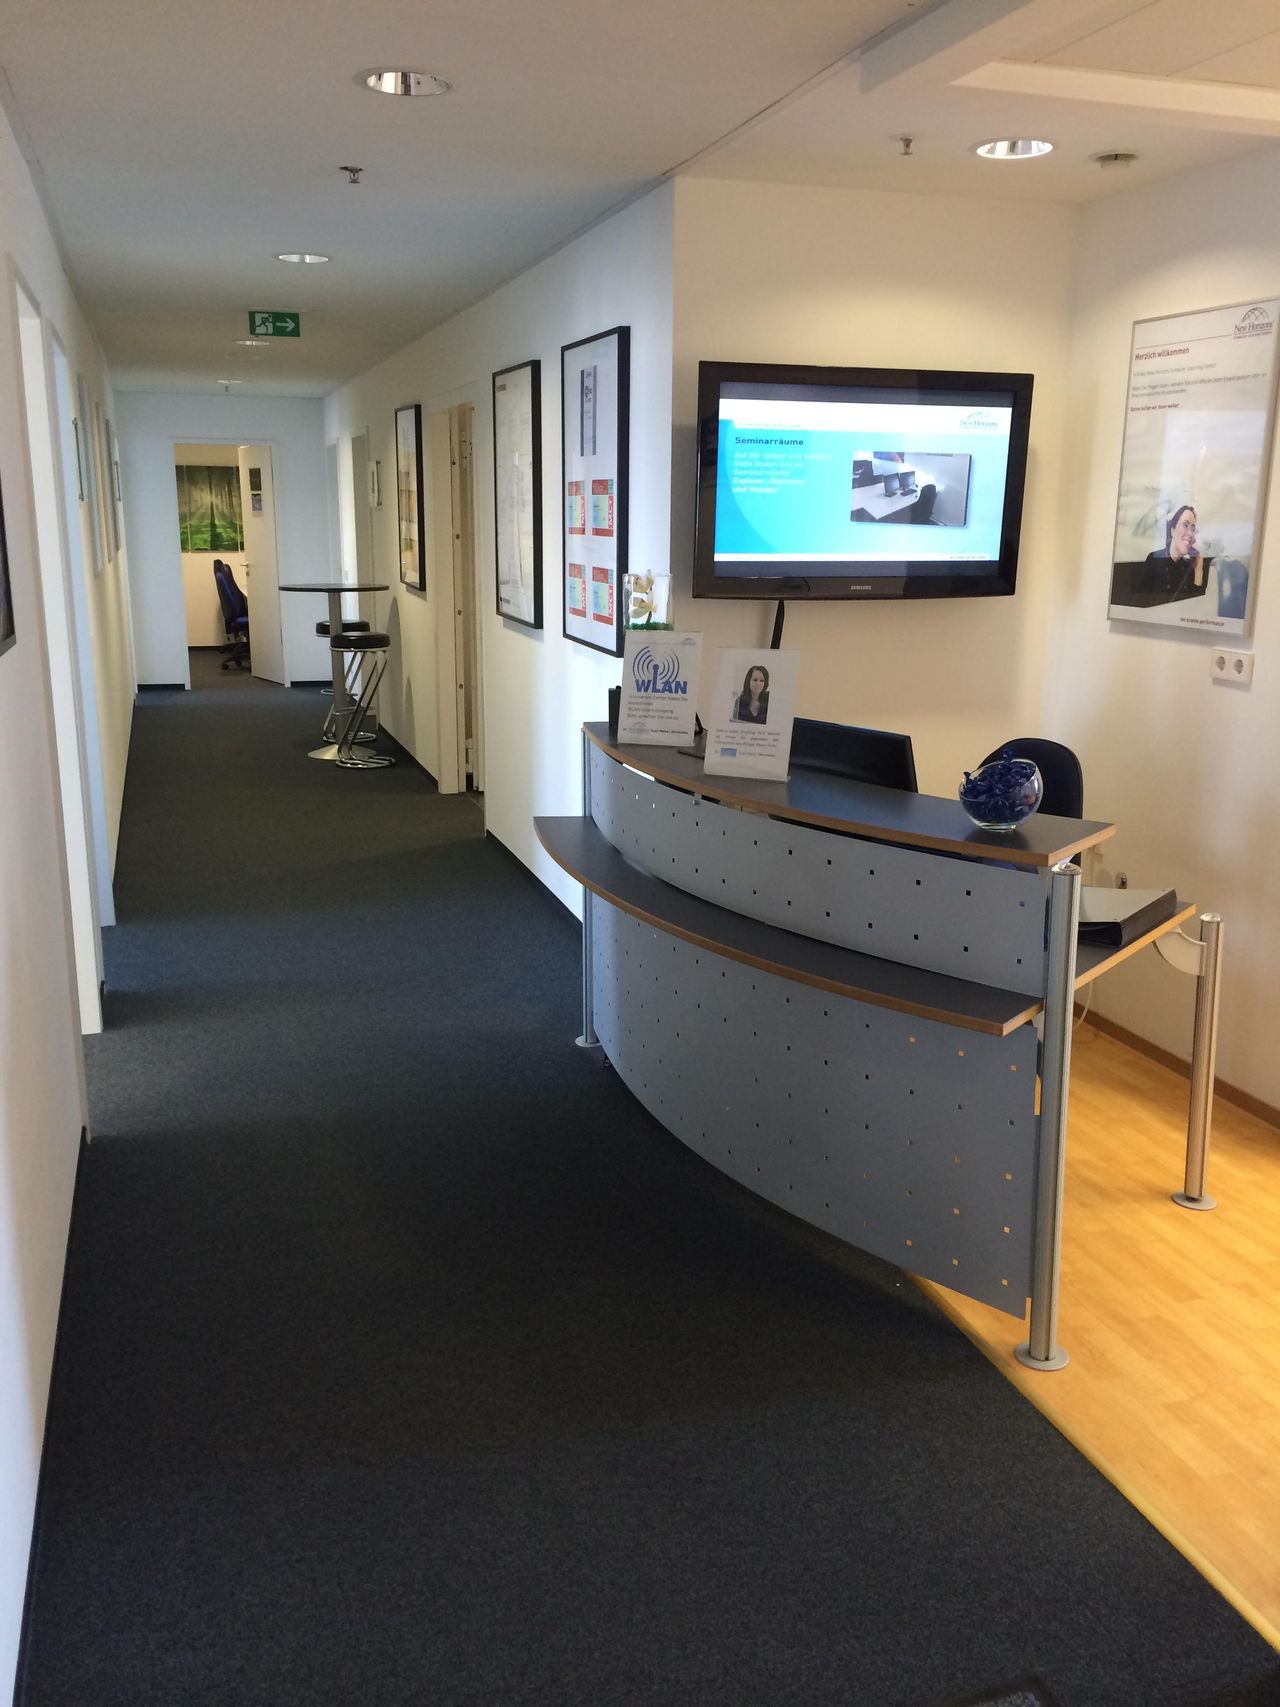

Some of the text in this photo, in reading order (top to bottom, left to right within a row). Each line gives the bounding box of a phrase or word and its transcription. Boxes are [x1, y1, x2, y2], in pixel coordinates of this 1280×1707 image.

[1135, 347, 1190, 361] Herzlich willkommen
[735, 436, 804, 446] Seminarräume
[635, 675, 688, 694] WLAN
